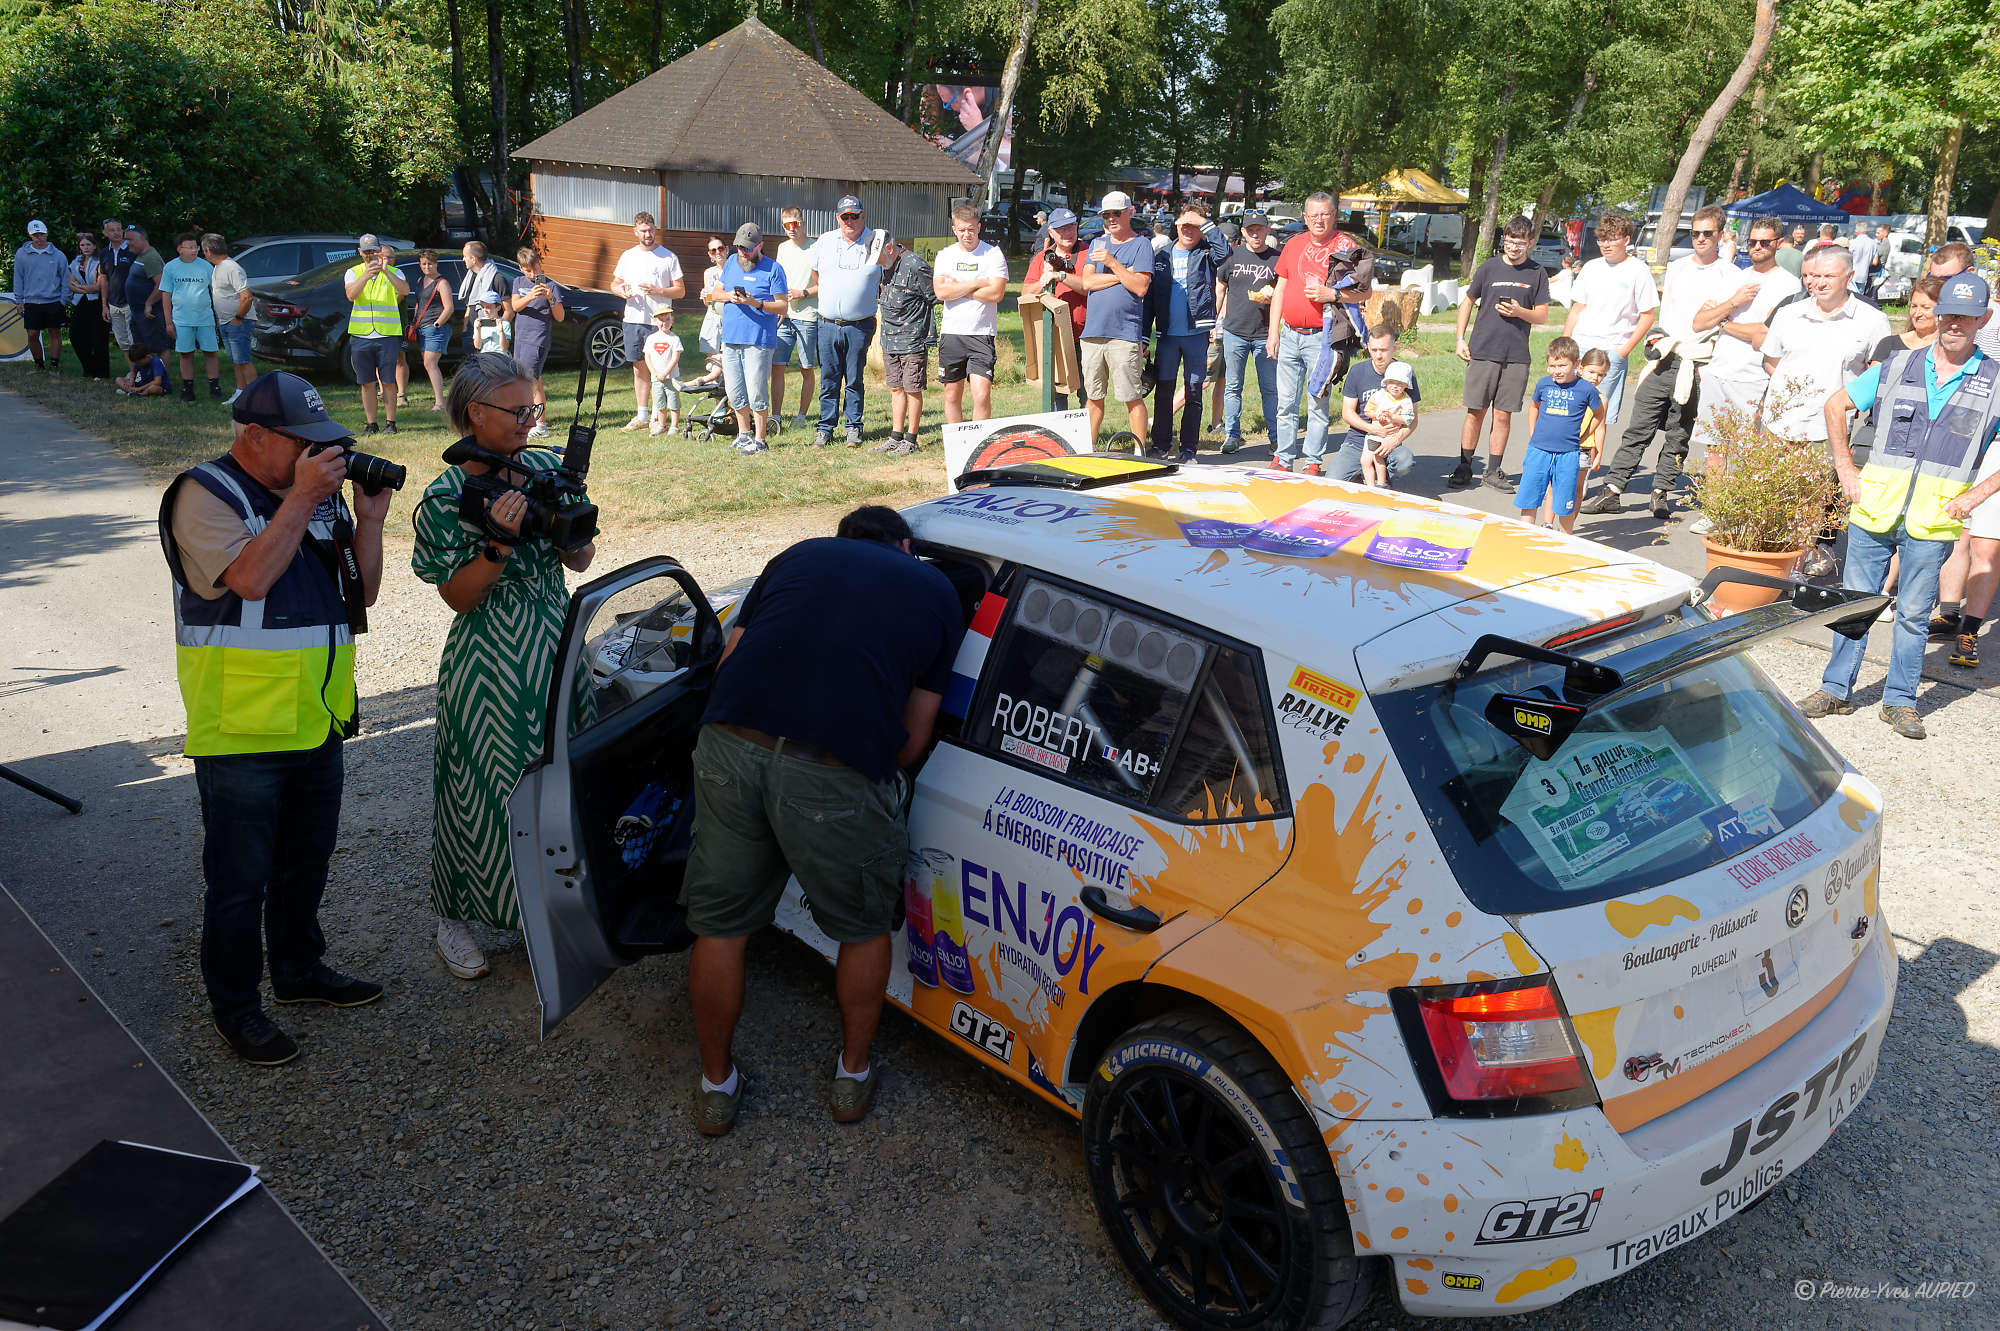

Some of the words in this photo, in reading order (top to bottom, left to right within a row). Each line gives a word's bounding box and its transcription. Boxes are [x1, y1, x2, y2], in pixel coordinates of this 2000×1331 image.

[932, 493, 1093, 523] ENJOY
[1258, 529, 1337, 547] ENJOY
[1375, 541, 1458, 560] ENJOY
[343, 547, 358, 580] Canon
[1294, 670, 1356, 708] PIRELLI
[991, 692, 1101, 762] ROBERT
[1277, 692, 1351, 737] RALLYE
[1516, 711, 1550, 730] OMP
[1575, 755, 1658, 803] CENTRE-BRETAGNE
[1591, 744, 1628, 776] RALLYE
[1540, 778, 1557, 796] 3
[994, 785, 1015, 809] LA
[1011, 793, 1068, 830] BOISSON
[1062, 813, 1144, 861] FRANÇAISE
[982, 803, 993, 832] À
[995, 810, 1057, 859] ÉNERGIE
[1056, 838, 1129, 890] POSITIVE
[1727, 854, 1777, 890] ECURIE
[1763, 832, 1823, 872] BRETAGNE
[960, 857, 1105, 996] ENJOY
[1622, 933, 1701, 971] Boulangerie
[1709, 908, 1759, 942] Pâtisserie
[937, 946, 966, 969] ENJOY
[998, 941, 1043, 986] HYDRATION
[1041, 970, 1066, 1010] REMEDY
[1691, 948, 1738, 978] PLUHERLIN
[1121, 1043, 1203, 1072] MICHELIN
[1213, 1075, 1241, 1102] PILOT
[1240, 1102, 1270, 1139] SPORT
[1700, 1031, 1868, 1187] JSTP
[1828, 1097, 1844, 1129] LA
[1606, 1206, 1709, 1270] Travaux
[1714, 1158, 1784, 1220] Publics
[1444, 1275, 1481, 1289] OMP
